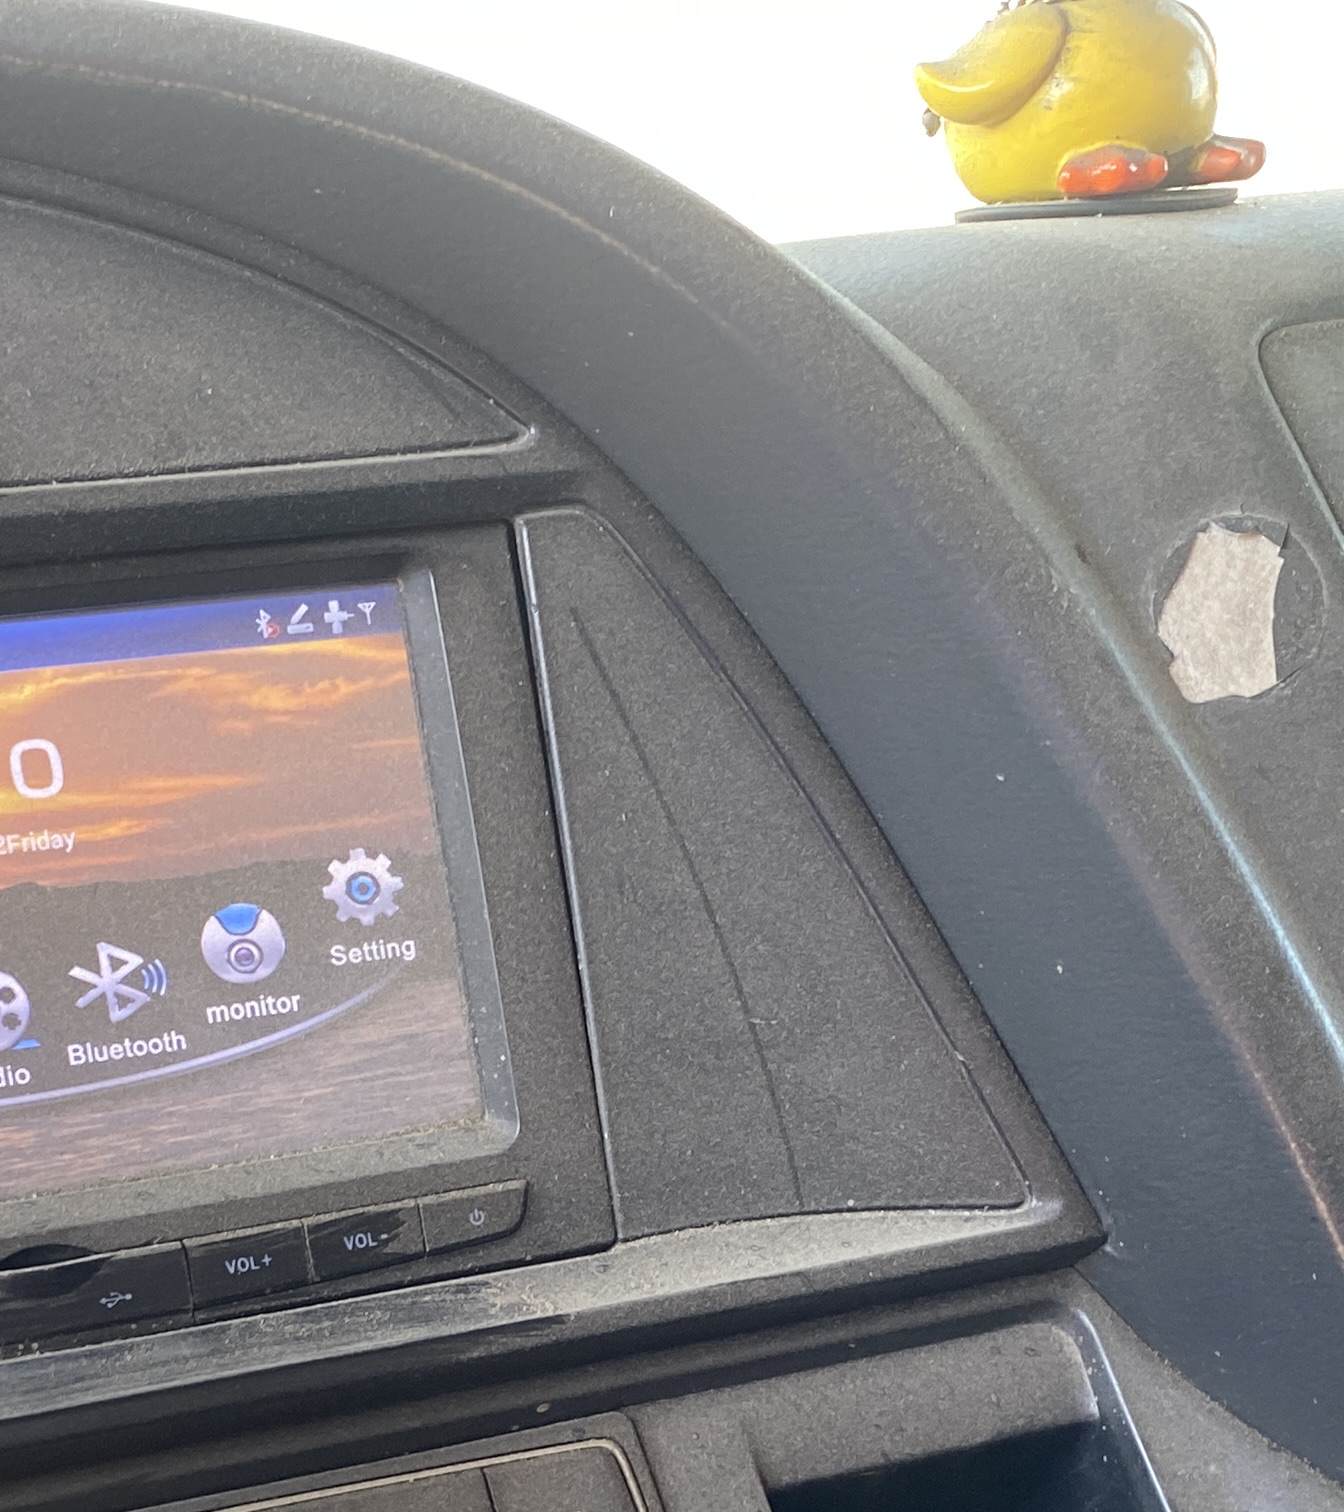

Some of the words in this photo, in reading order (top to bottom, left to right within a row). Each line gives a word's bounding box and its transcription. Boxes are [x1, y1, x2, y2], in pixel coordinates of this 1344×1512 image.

[330, 938, 417, 966] Setting
[205, 993, 301, 1024] monitor
[67, 1030, 187, 1067] Bluetooth
